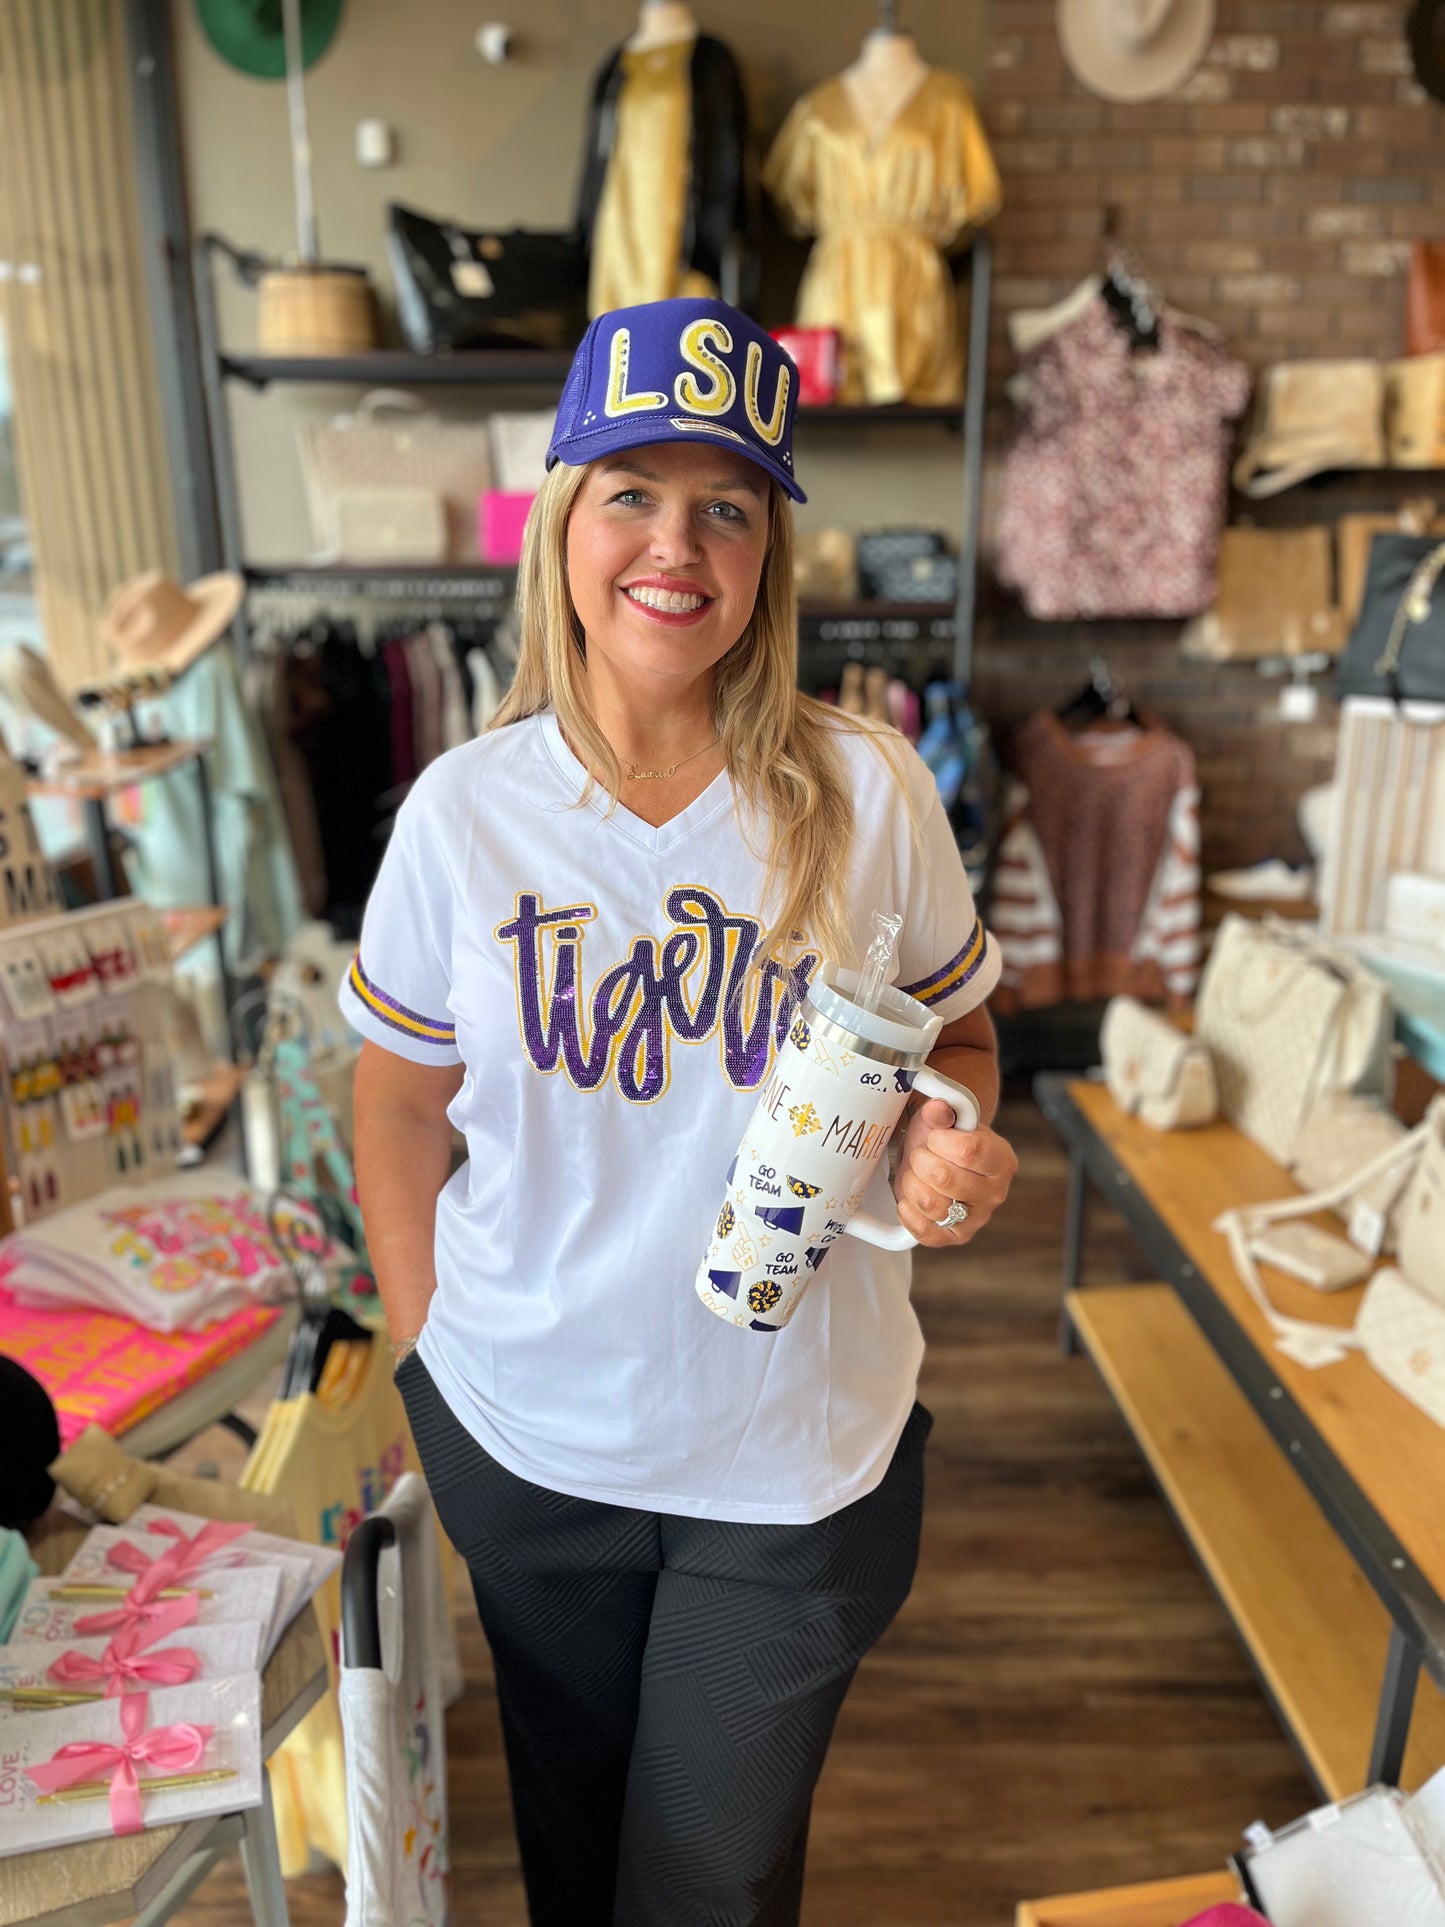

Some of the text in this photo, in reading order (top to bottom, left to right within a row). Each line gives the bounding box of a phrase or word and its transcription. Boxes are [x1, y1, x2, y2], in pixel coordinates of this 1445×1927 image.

[604, 318, 790, 447] LSU
[860, 1073, 881, 1085] GO
[821, 1115, 892, 1160] MARIE
[758, 1164, 776, 1179] GO
[749, 1174, 782, 1198] TEAM
[775, 1252, 794, 1263] GO
[765, 1264, 798, 1275] TEAM
